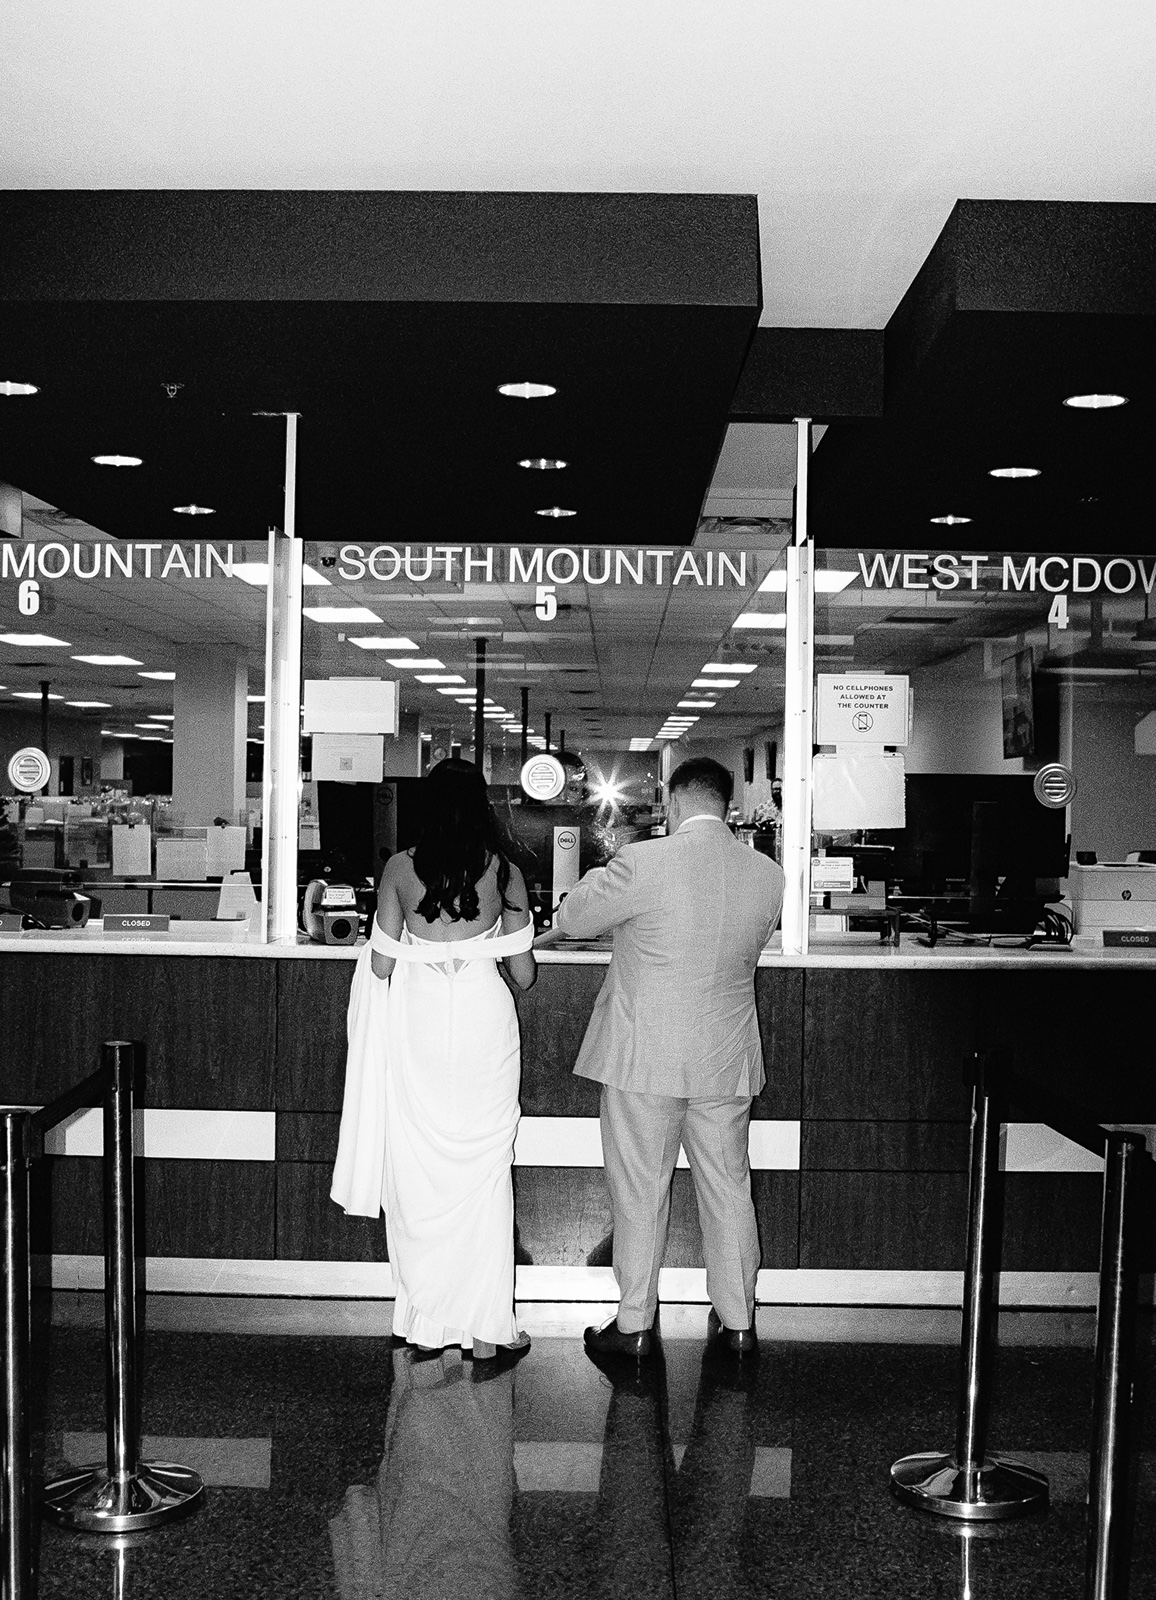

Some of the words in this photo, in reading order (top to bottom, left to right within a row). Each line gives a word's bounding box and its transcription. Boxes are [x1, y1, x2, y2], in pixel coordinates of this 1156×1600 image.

[2, 543, 233, 578] MOUNTAIN
[338, 545, 493, 582] SOUTH
[509, 547, 746, 586] MOUNTAIN
[857, 553, 989, 590] WEST
[18, 580, 40, 616] 6
[535, 585, 557, 621] 5
[1047, 594, 1069, 629] 4
[1120, 935, 1150, 943] CLOSED
